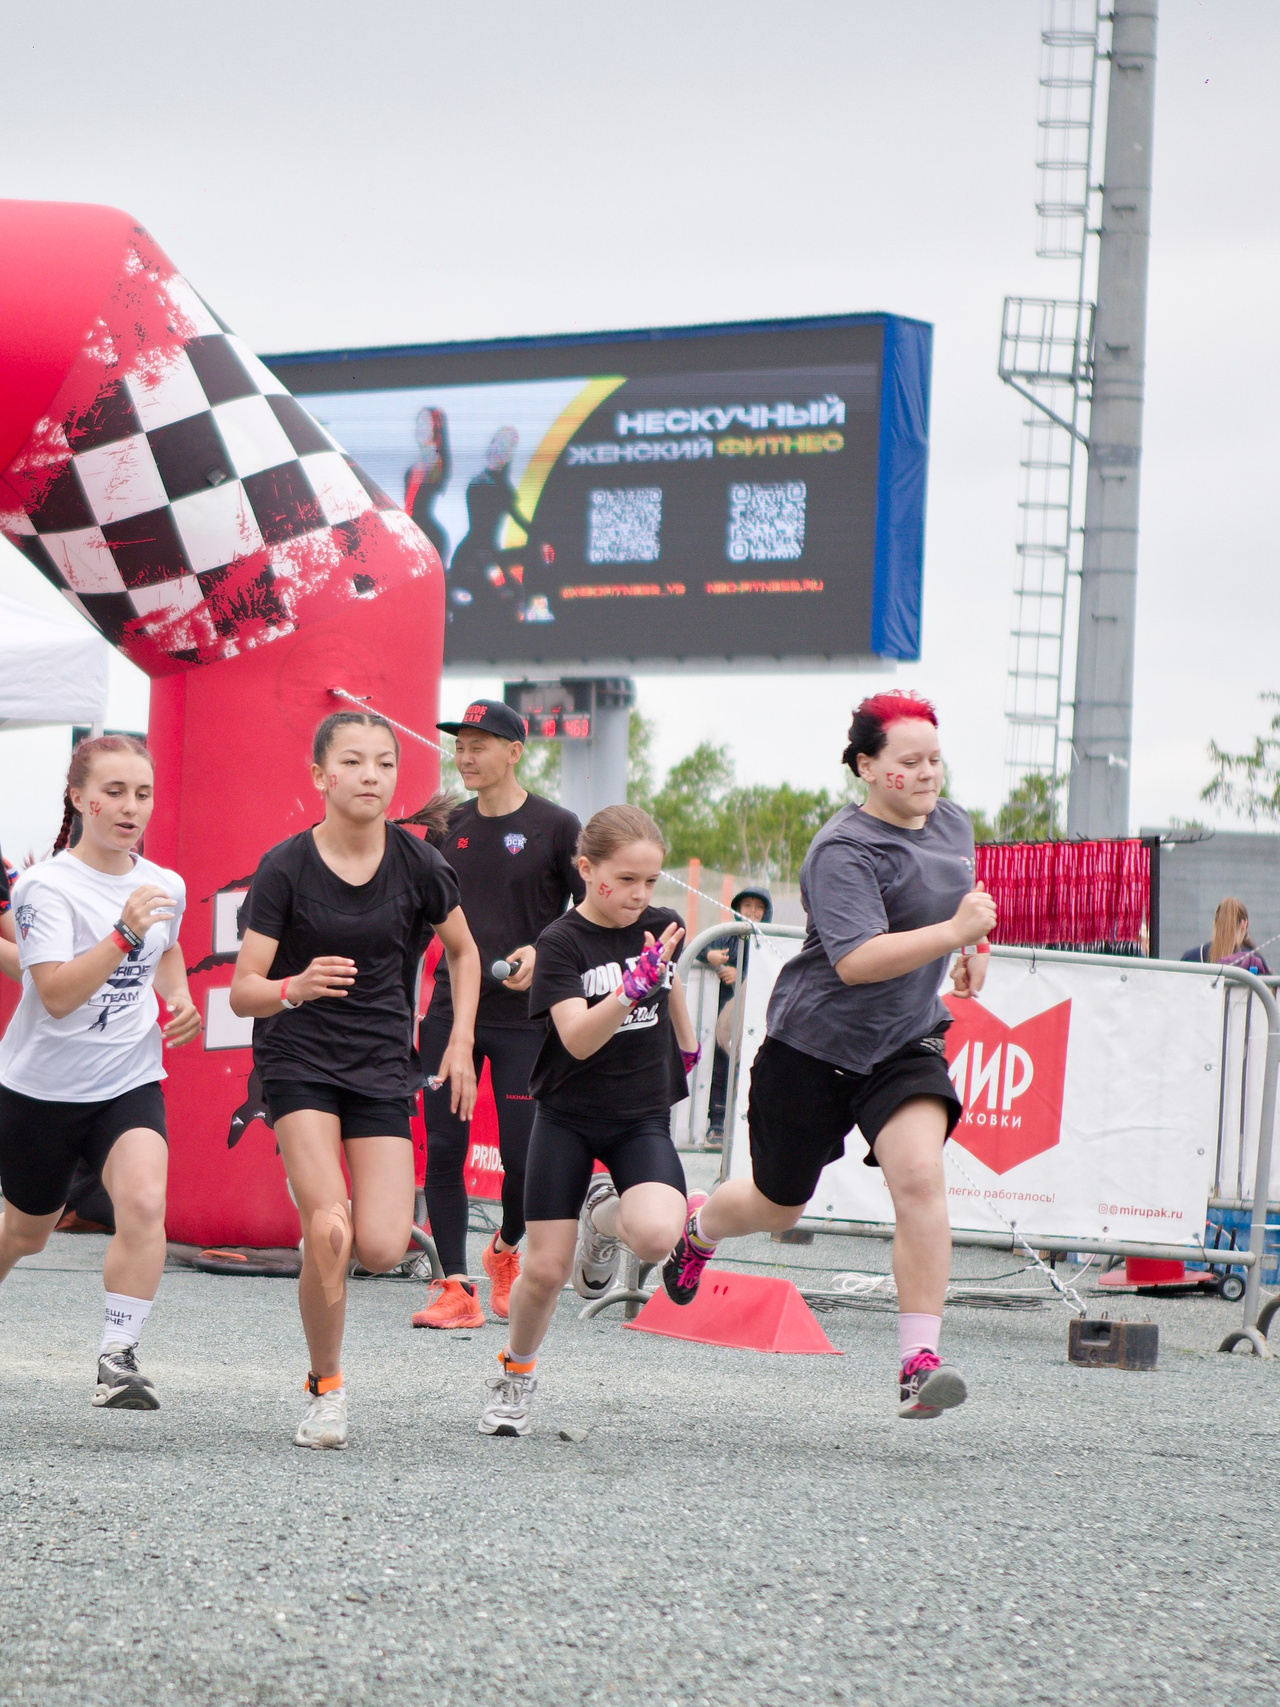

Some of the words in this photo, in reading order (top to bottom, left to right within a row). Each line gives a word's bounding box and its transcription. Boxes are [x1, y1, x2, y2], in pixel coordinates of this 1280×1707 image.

[616, 393, 846, 436] НЕСКУЧНЫЙ
[567, 436, 714, 464] ЖЕНСКИЙ
[715, 431, 845, 456] ФИТНЕС
[462, 713, 482, 723] EAM
[885, 772, 905, 790] 56
[112, 965, 151, 978] RIDE
[581, 962, 624, 998] OOD
[101, 991, 140, 1004] TEAM
[959, 1111, 1022, 1129] КОВКИ
[947, 1186, 981, 1199] легко
[984, 1189, 1056, 1203] работалось!
[1119, 1205, 1183, 1219] mirupak.ru
